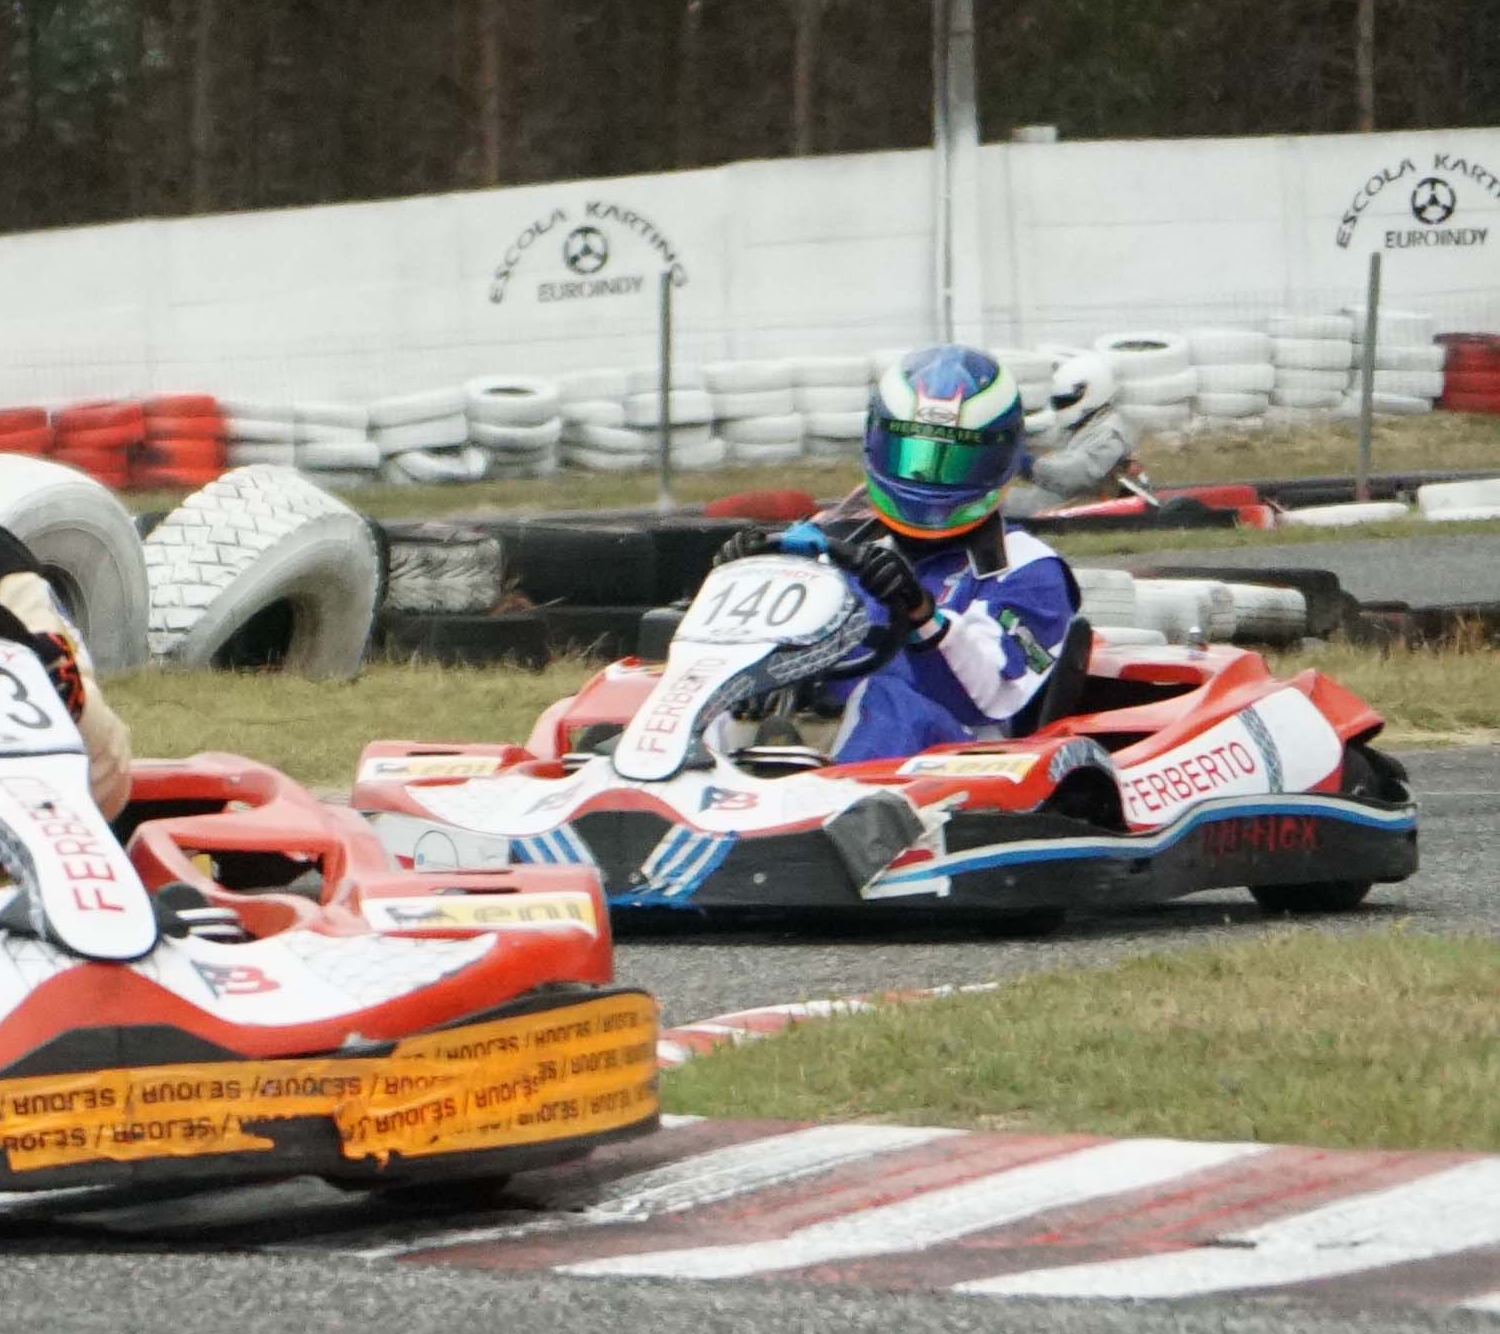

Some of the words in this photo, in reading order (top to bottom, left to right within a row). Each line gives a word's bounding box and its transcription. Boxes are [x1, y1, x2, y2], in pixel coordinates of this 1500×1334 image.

[1336, 157, 1417, 249] ESCOLA
[1434, 153, 1500, 200] KART
[489, 208, 567, 304] ESCOLA
[586, 201, 689, 288] KARTING
[1385, 227, 1488, 248] EUROINDY
[538, 275, 644, 303] EUROINDY
[703, 580, 808, 627] 140
[1124, 741, 1256, 818] FERBERTO
[472, 900, 584, 923] eni
